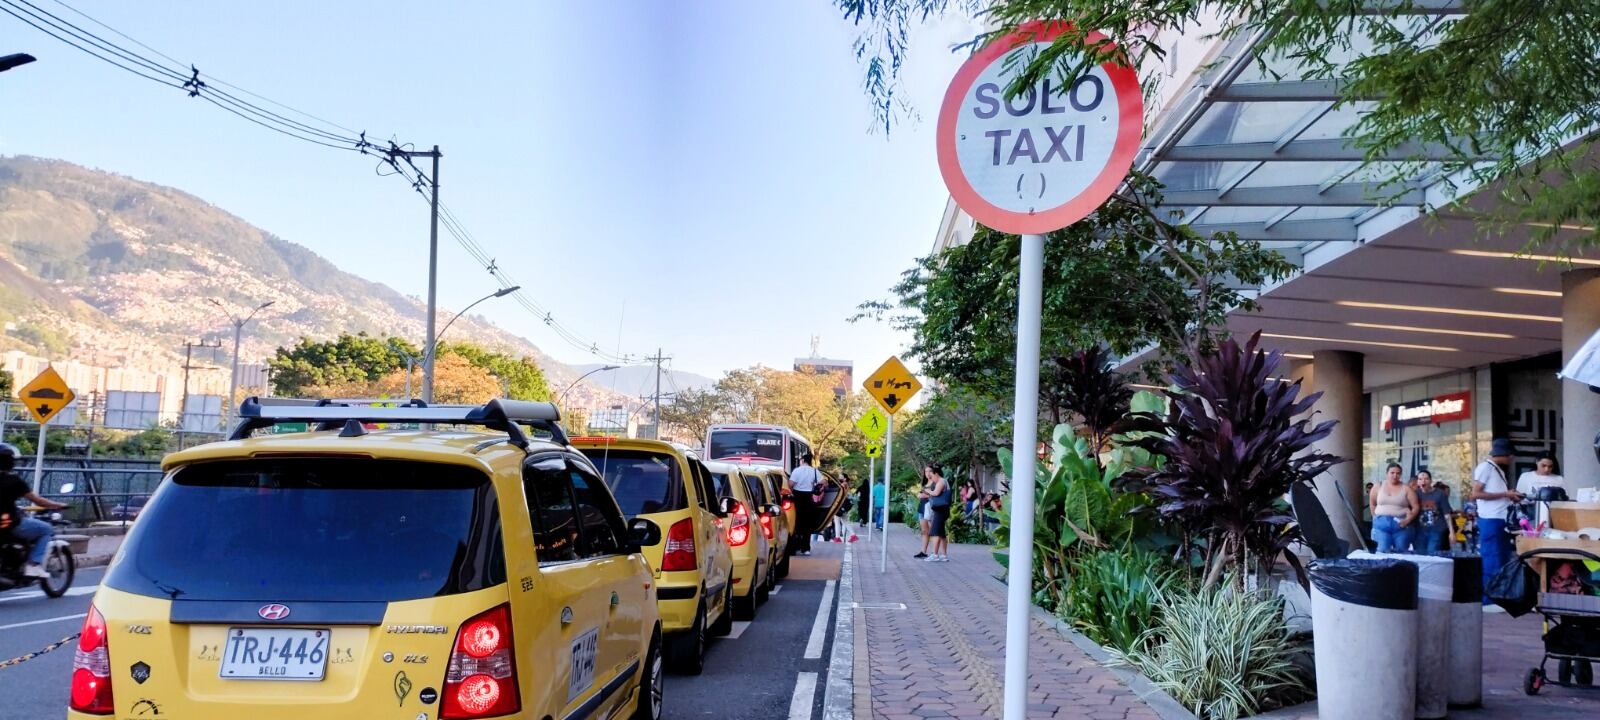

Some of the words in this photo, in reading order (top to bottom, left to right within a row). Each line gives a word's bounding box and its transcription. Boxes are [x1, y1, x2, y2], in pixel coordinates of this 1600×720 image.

[973, 74, 1104, 119] SOLO
[985, 124, 1086, 166] TAXI
[522, 580, 534, 592] 525
[386, 625, 449, 635] HYUNDAI
[258, 666, 287, 676] BELLO
